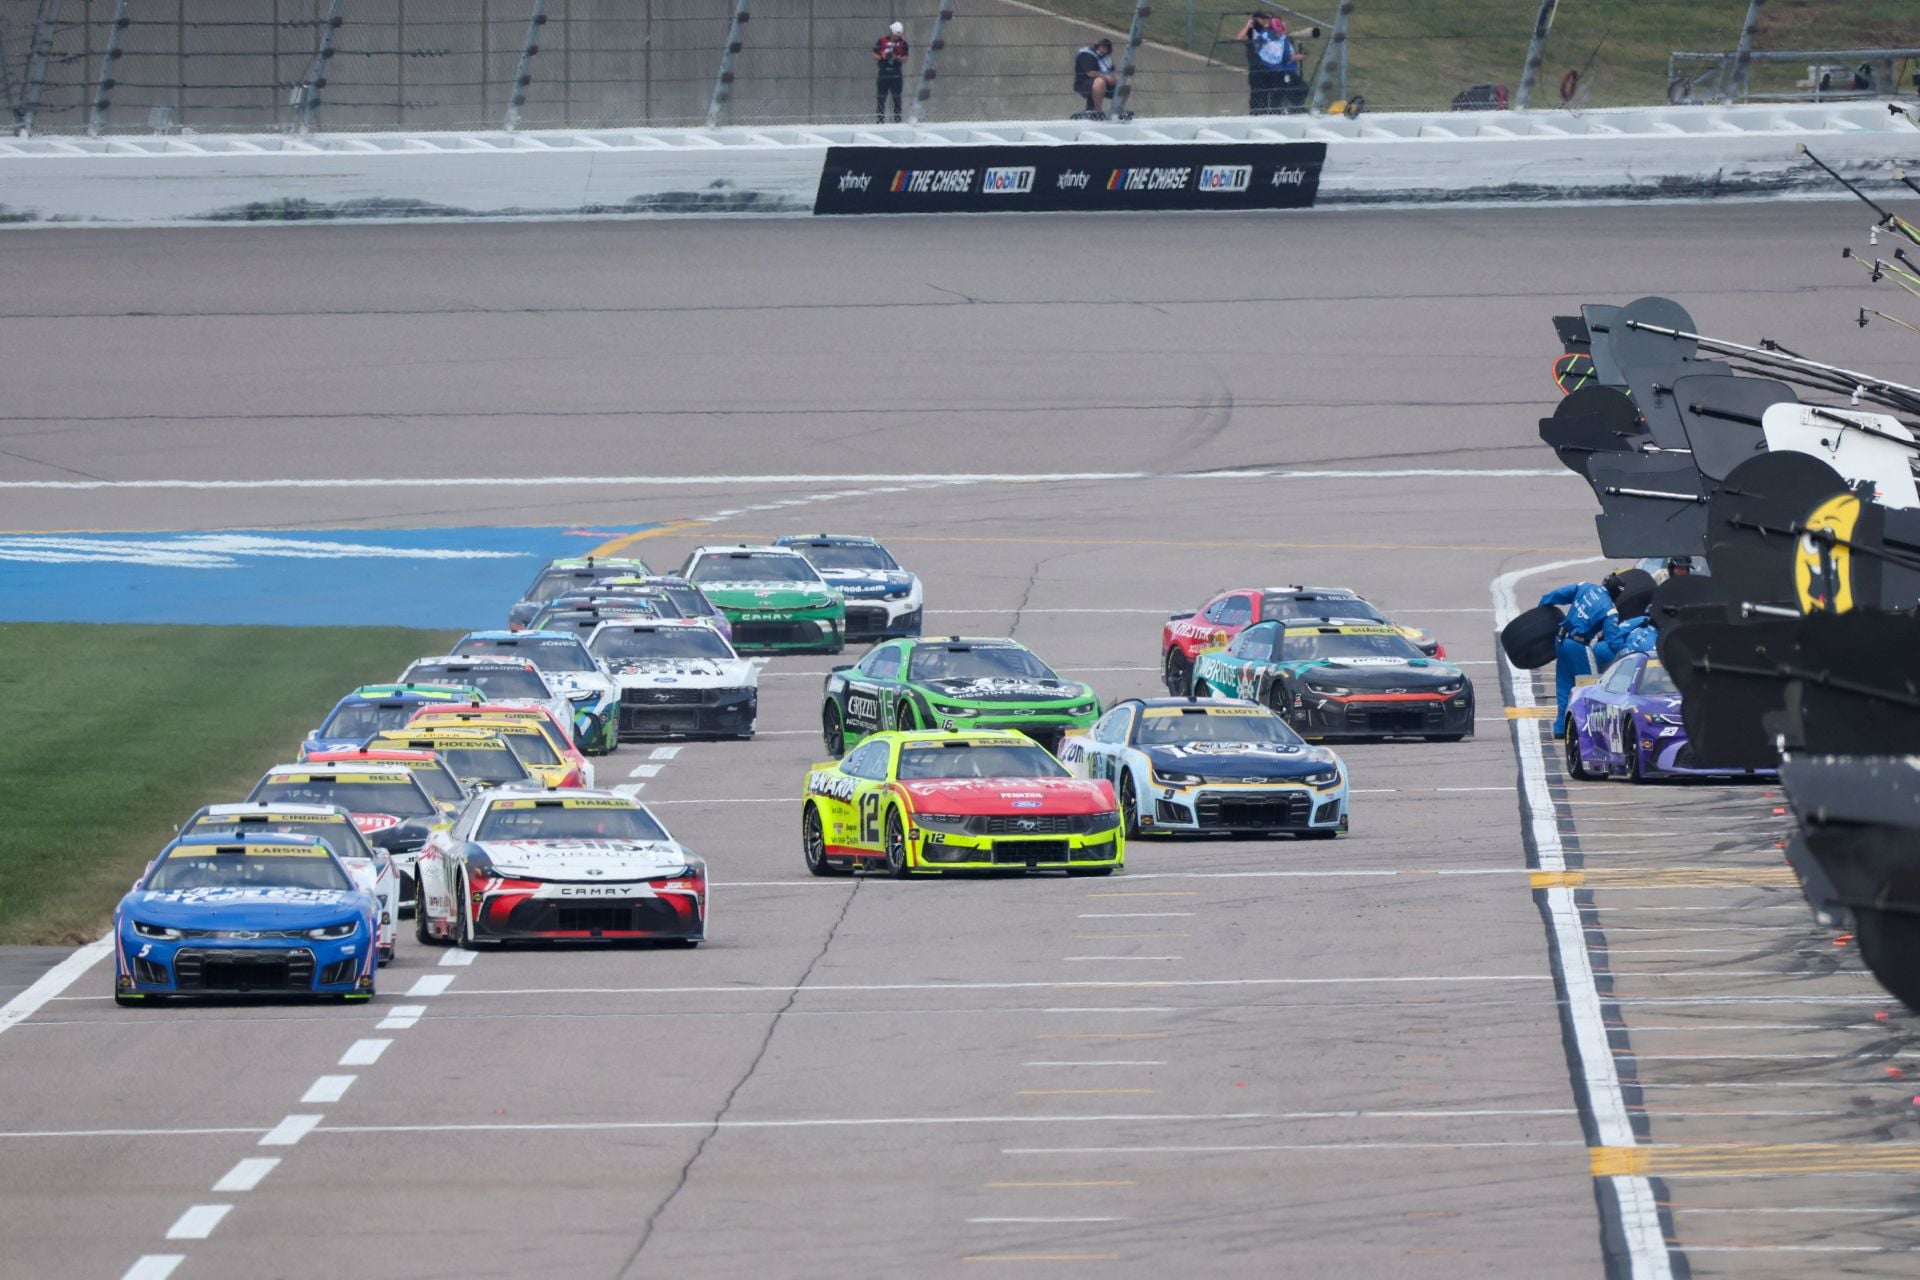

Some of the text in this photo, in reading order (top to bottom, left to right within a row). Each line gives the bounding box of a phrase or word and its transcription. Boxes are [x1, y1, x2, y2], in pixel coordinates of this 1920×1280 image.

[838, 169, 872, 192] xfinity
[908, 169, 975, 192] THE CHASE
[985, 170, 1017, 189] Mobil
[1057, 169, 1091, 189] xfinity
[1124, 167, 1191, 190] THE CHASE
[1202, 169, 1234, 188] Mobil
[1271, 166, 1306, 187] xfinity
[742, 613, 793, 621] CAMRY
[847, 695, 878, 719] GRIZZLY
[1316, 699, 1328, 711] 7
[1659, 726, 1679, 737] 23
[1163, 789, 1176, 800] 9
[858, 792, 880, 843] 12
[930, 833, 946, 844] 12
[253, 847, 312, 855] LARSON
[561, 888, 632, 896] CAMRY
[138, 945, 152, 957] 5
